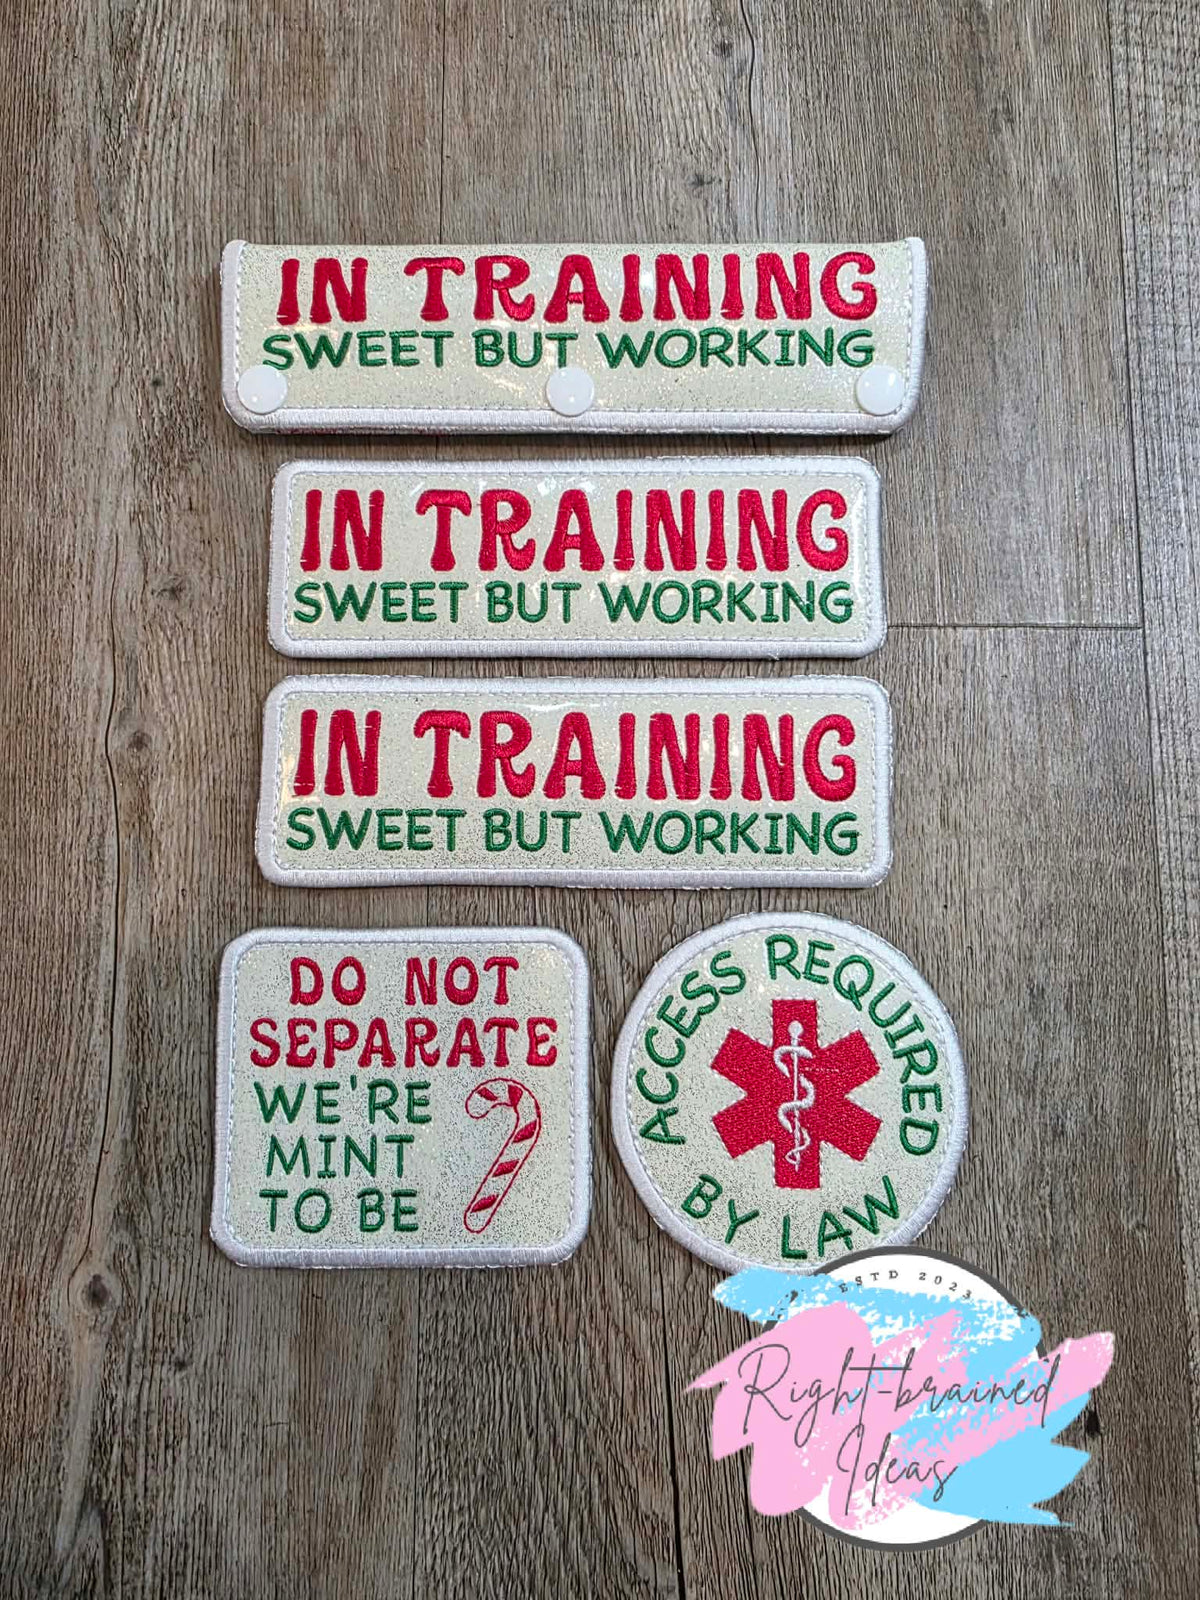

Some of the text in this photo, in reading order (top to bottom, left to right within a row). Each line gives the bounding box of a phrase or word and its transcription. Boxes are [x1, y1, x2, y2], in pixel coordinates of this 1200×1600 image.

[277, 252, 877, 325] IN TRAINING
[262, 327, 874, 371] SWEET BUT WORKING
[300, 489, 848, 572] IN TRAINING
[294, 580, 853, 624] SWEET BUT WORKING
[294, 709, 856, 801] IN TRAINING
[286, 808, 860, 856] SWEET BUT WORKING
[290, 957, 519, 1005] DO NOT
[250, 1017, 558, 1068] SEPARATE
[639, 934, 942, 1156] ACCESS REQUIRED
[254, 1075, 432, 1125] WE'RE
[266, 1134, 414, 1178] MINT
[259, 1188, 419, 1233] TO BE
[682, 1174, 899, 1259] BY LAW
